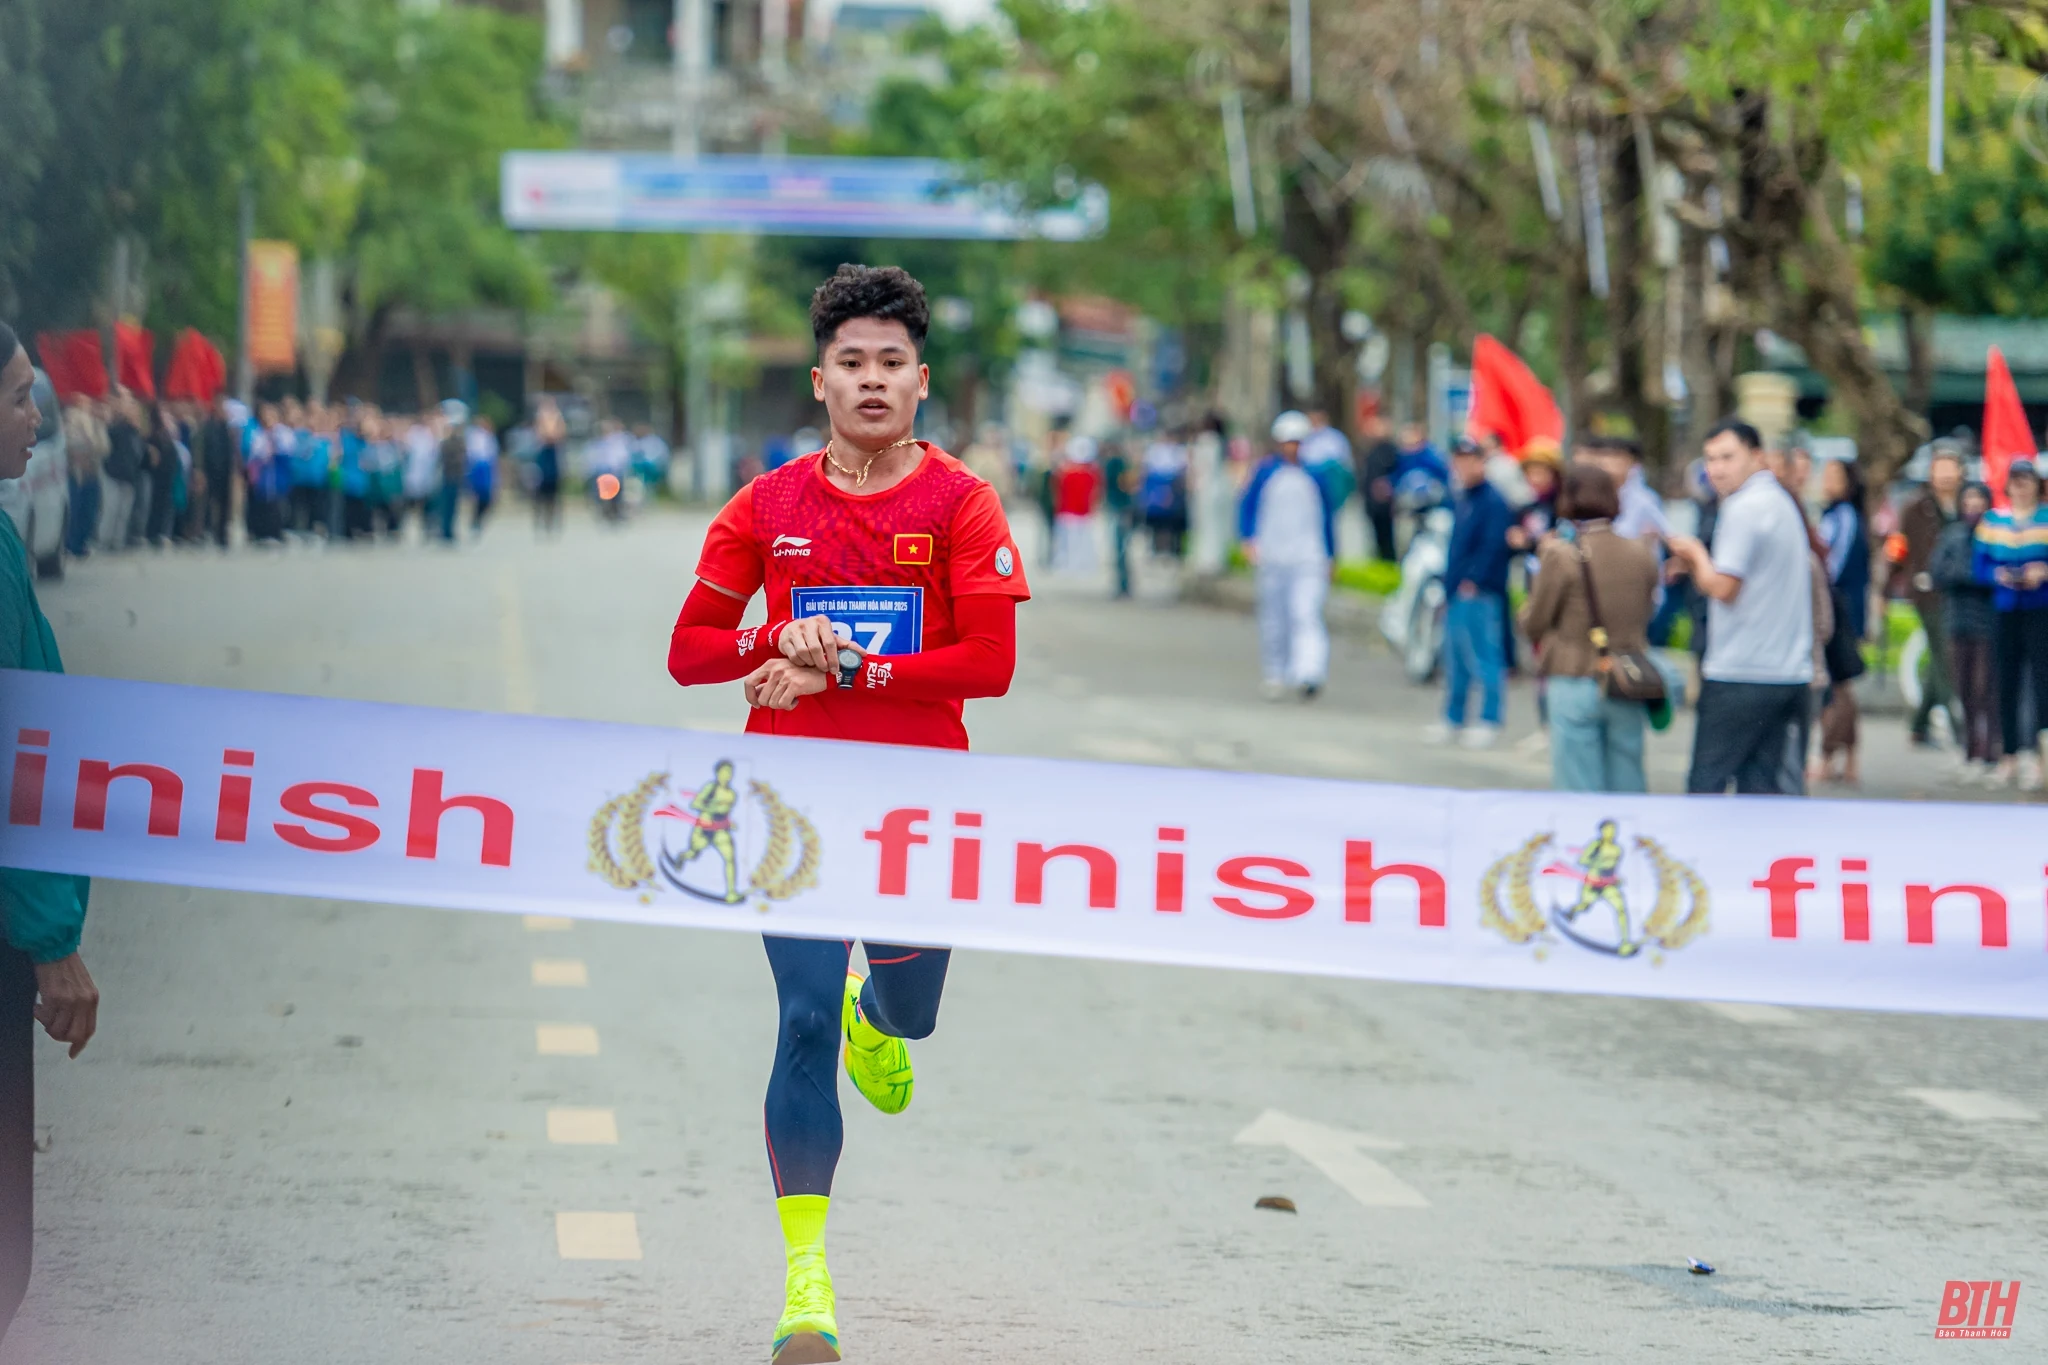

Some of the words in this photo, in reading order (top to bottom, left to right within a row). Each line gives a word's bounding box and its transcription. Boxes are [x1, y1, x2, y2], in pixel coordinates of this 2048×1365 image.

[773, 549, 811, 557] LI-NING
[805, 599, 817, 612] GIẢI
[817, 600, 828, 613] VIỆT
[836, 599, 848, 611] BÁO
[848, 601, 867, 611] THANH
[867, 599, 879, 611] HÓA
[879, 600, 894, 611] NĂM
[894, 601, 908, 612] 2025
[864, 808, 1446, 928] finish
[1752, 857, 2048, 952] fin
